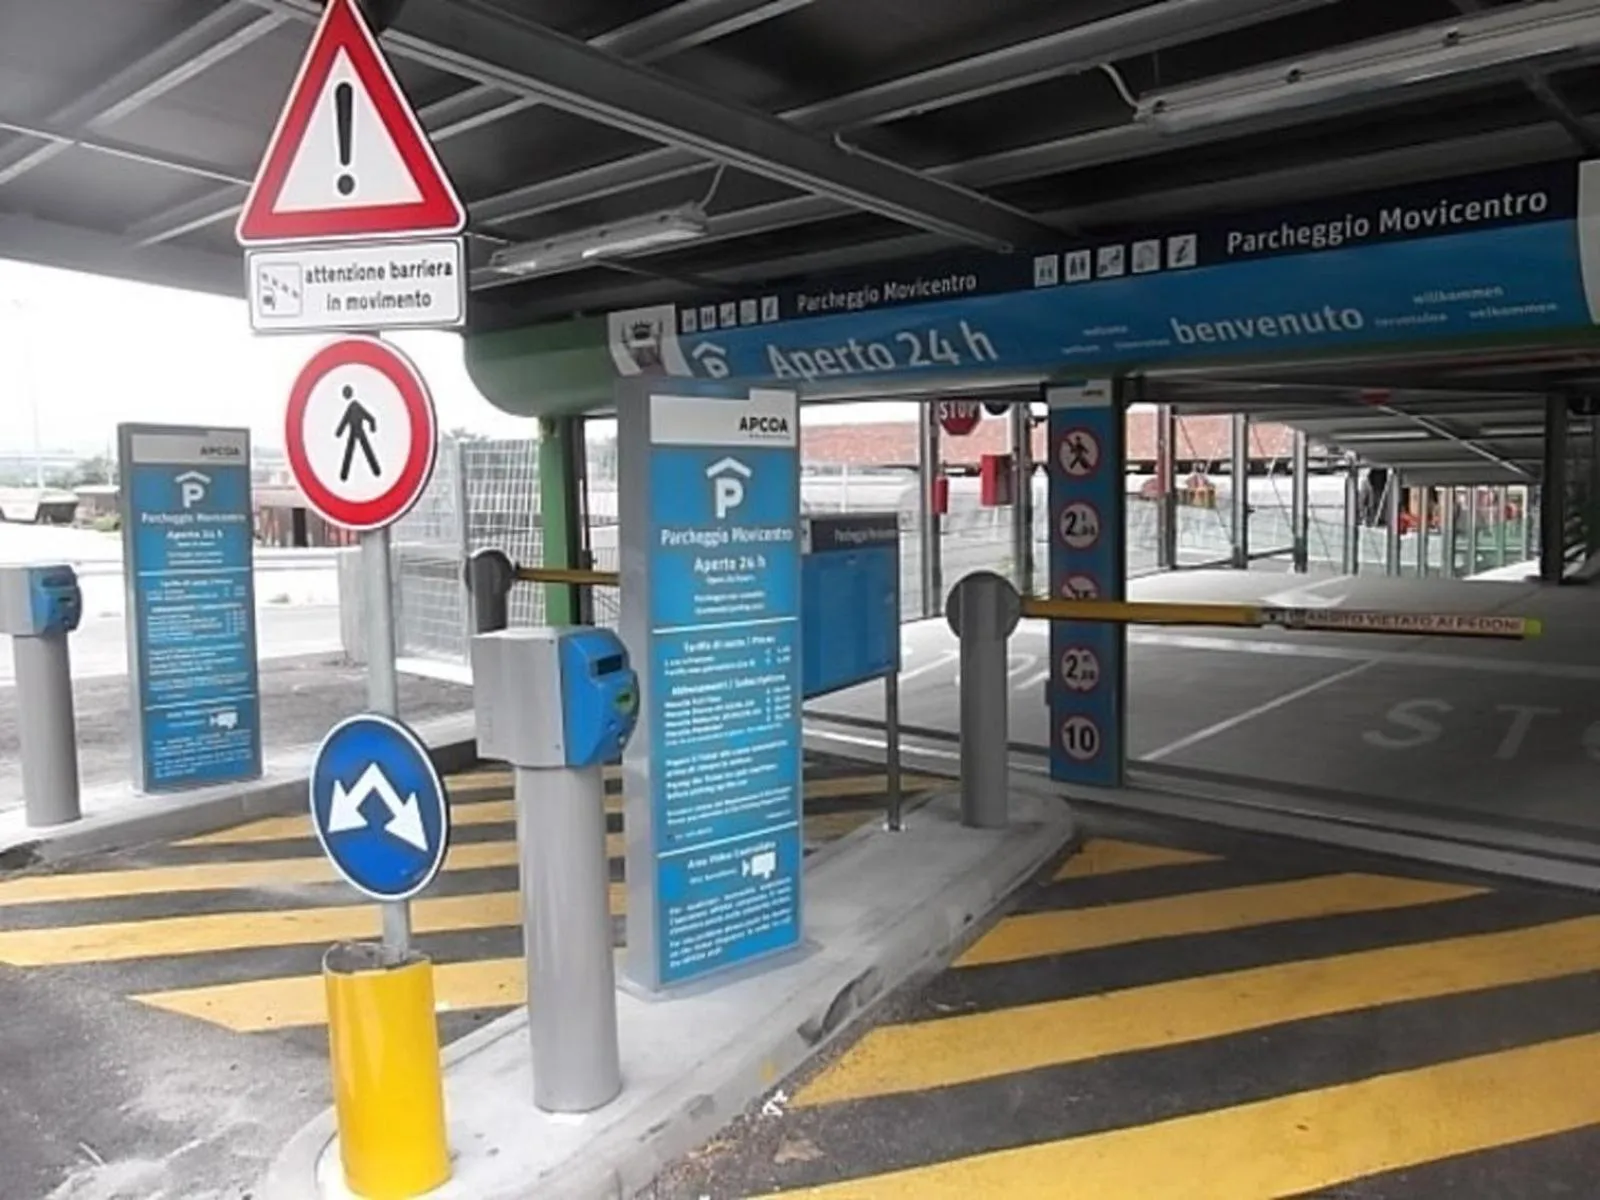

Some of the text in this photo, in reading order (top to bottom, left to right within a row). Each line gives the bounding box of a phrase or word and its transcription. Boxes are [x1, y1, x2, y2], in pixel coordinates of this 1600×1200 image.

[1226, 190, 1548, 257] Parcheggio Movicentro
[305, 259, 454, 285] attenzione barriera
[327, 289, 432, 312] in movimento
[797, 273, 977, 313] Parcheggio Movicentro
[1170, 303, 1364, 345] benvenuto
[767, 319, 998, 386] Aperto 24 h
[739, 415, 789, 433] APCOA
[1065, 723, 1096, 752] 10
[1361, 698, 1600, 762] ST
